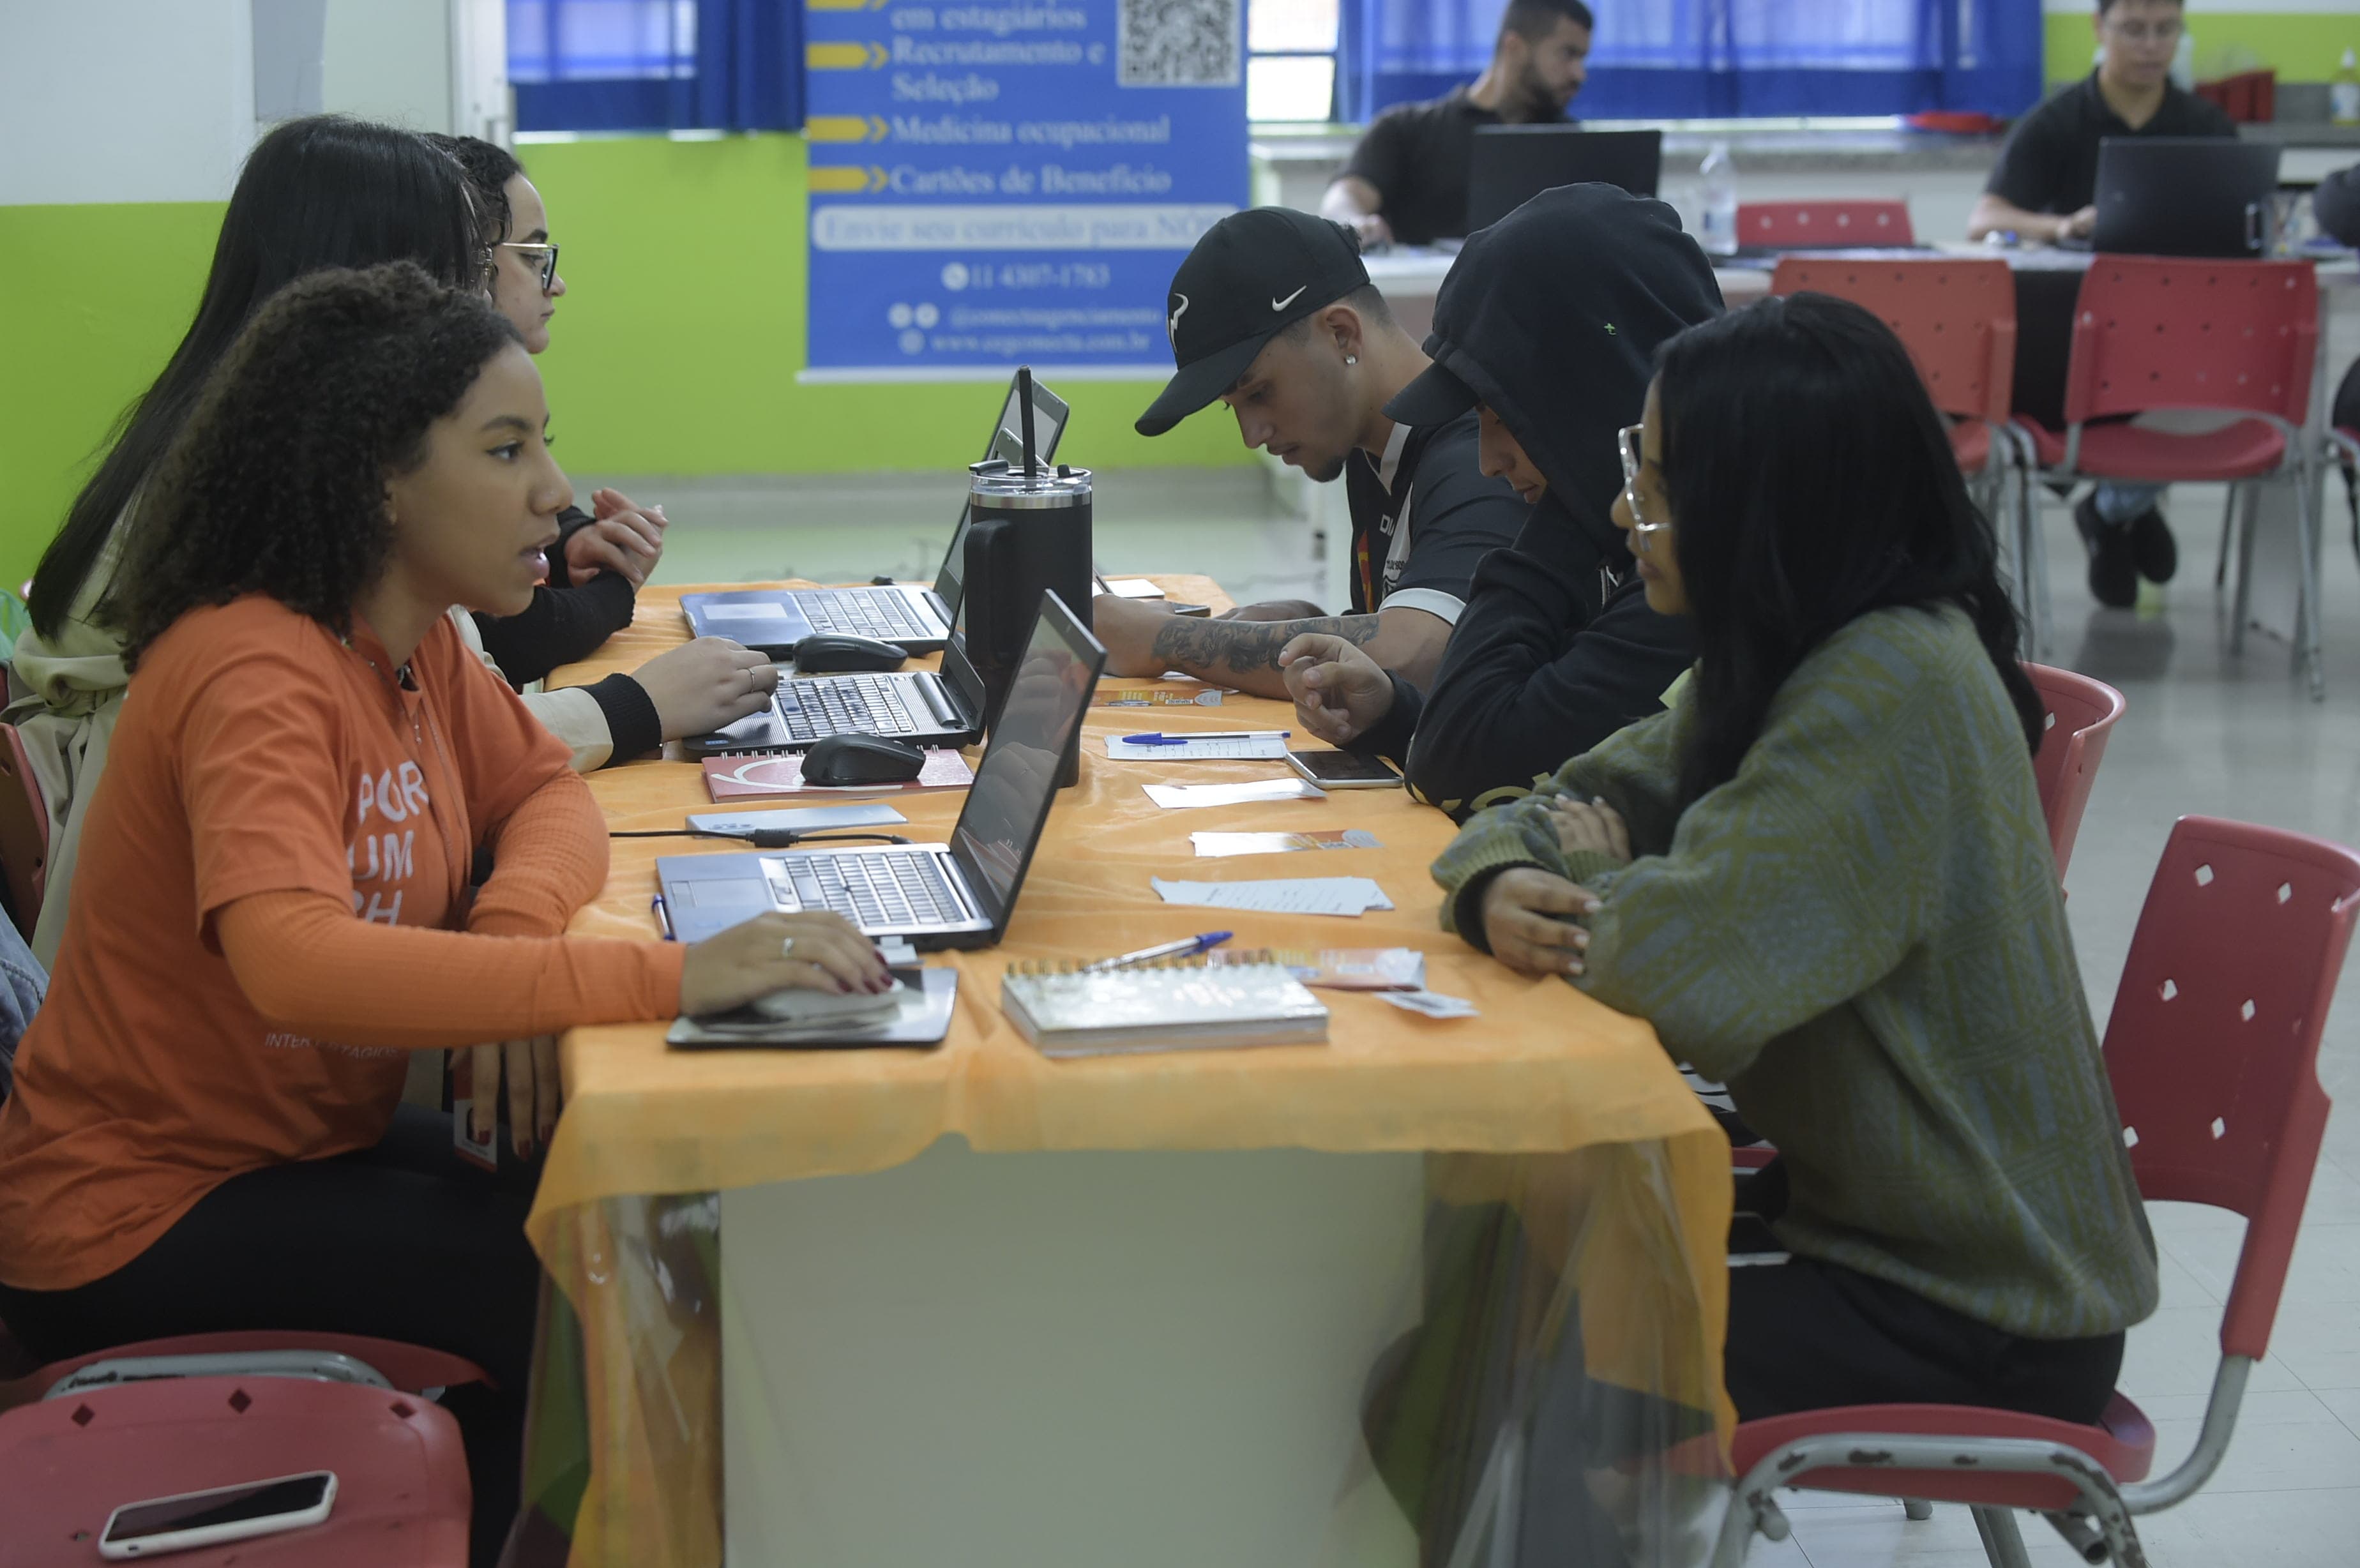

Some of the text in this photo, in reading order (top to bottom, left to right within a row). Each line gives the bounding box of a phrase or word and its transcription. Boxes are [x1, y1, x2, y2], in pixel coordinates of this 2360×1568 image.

[891, 8, 935, 30] em
[893, 36, 1106, 64] Recrutamento e
[893, 73, 999, 106] Seleção
[894, 114, 1170, 149] Medicina ocupacional
[891, 165, 995, 193] Cartões
[1000, 164, 1034, 193] de
[358, 760, 429, 826] POR
[347, 831, 414, 882] UM
